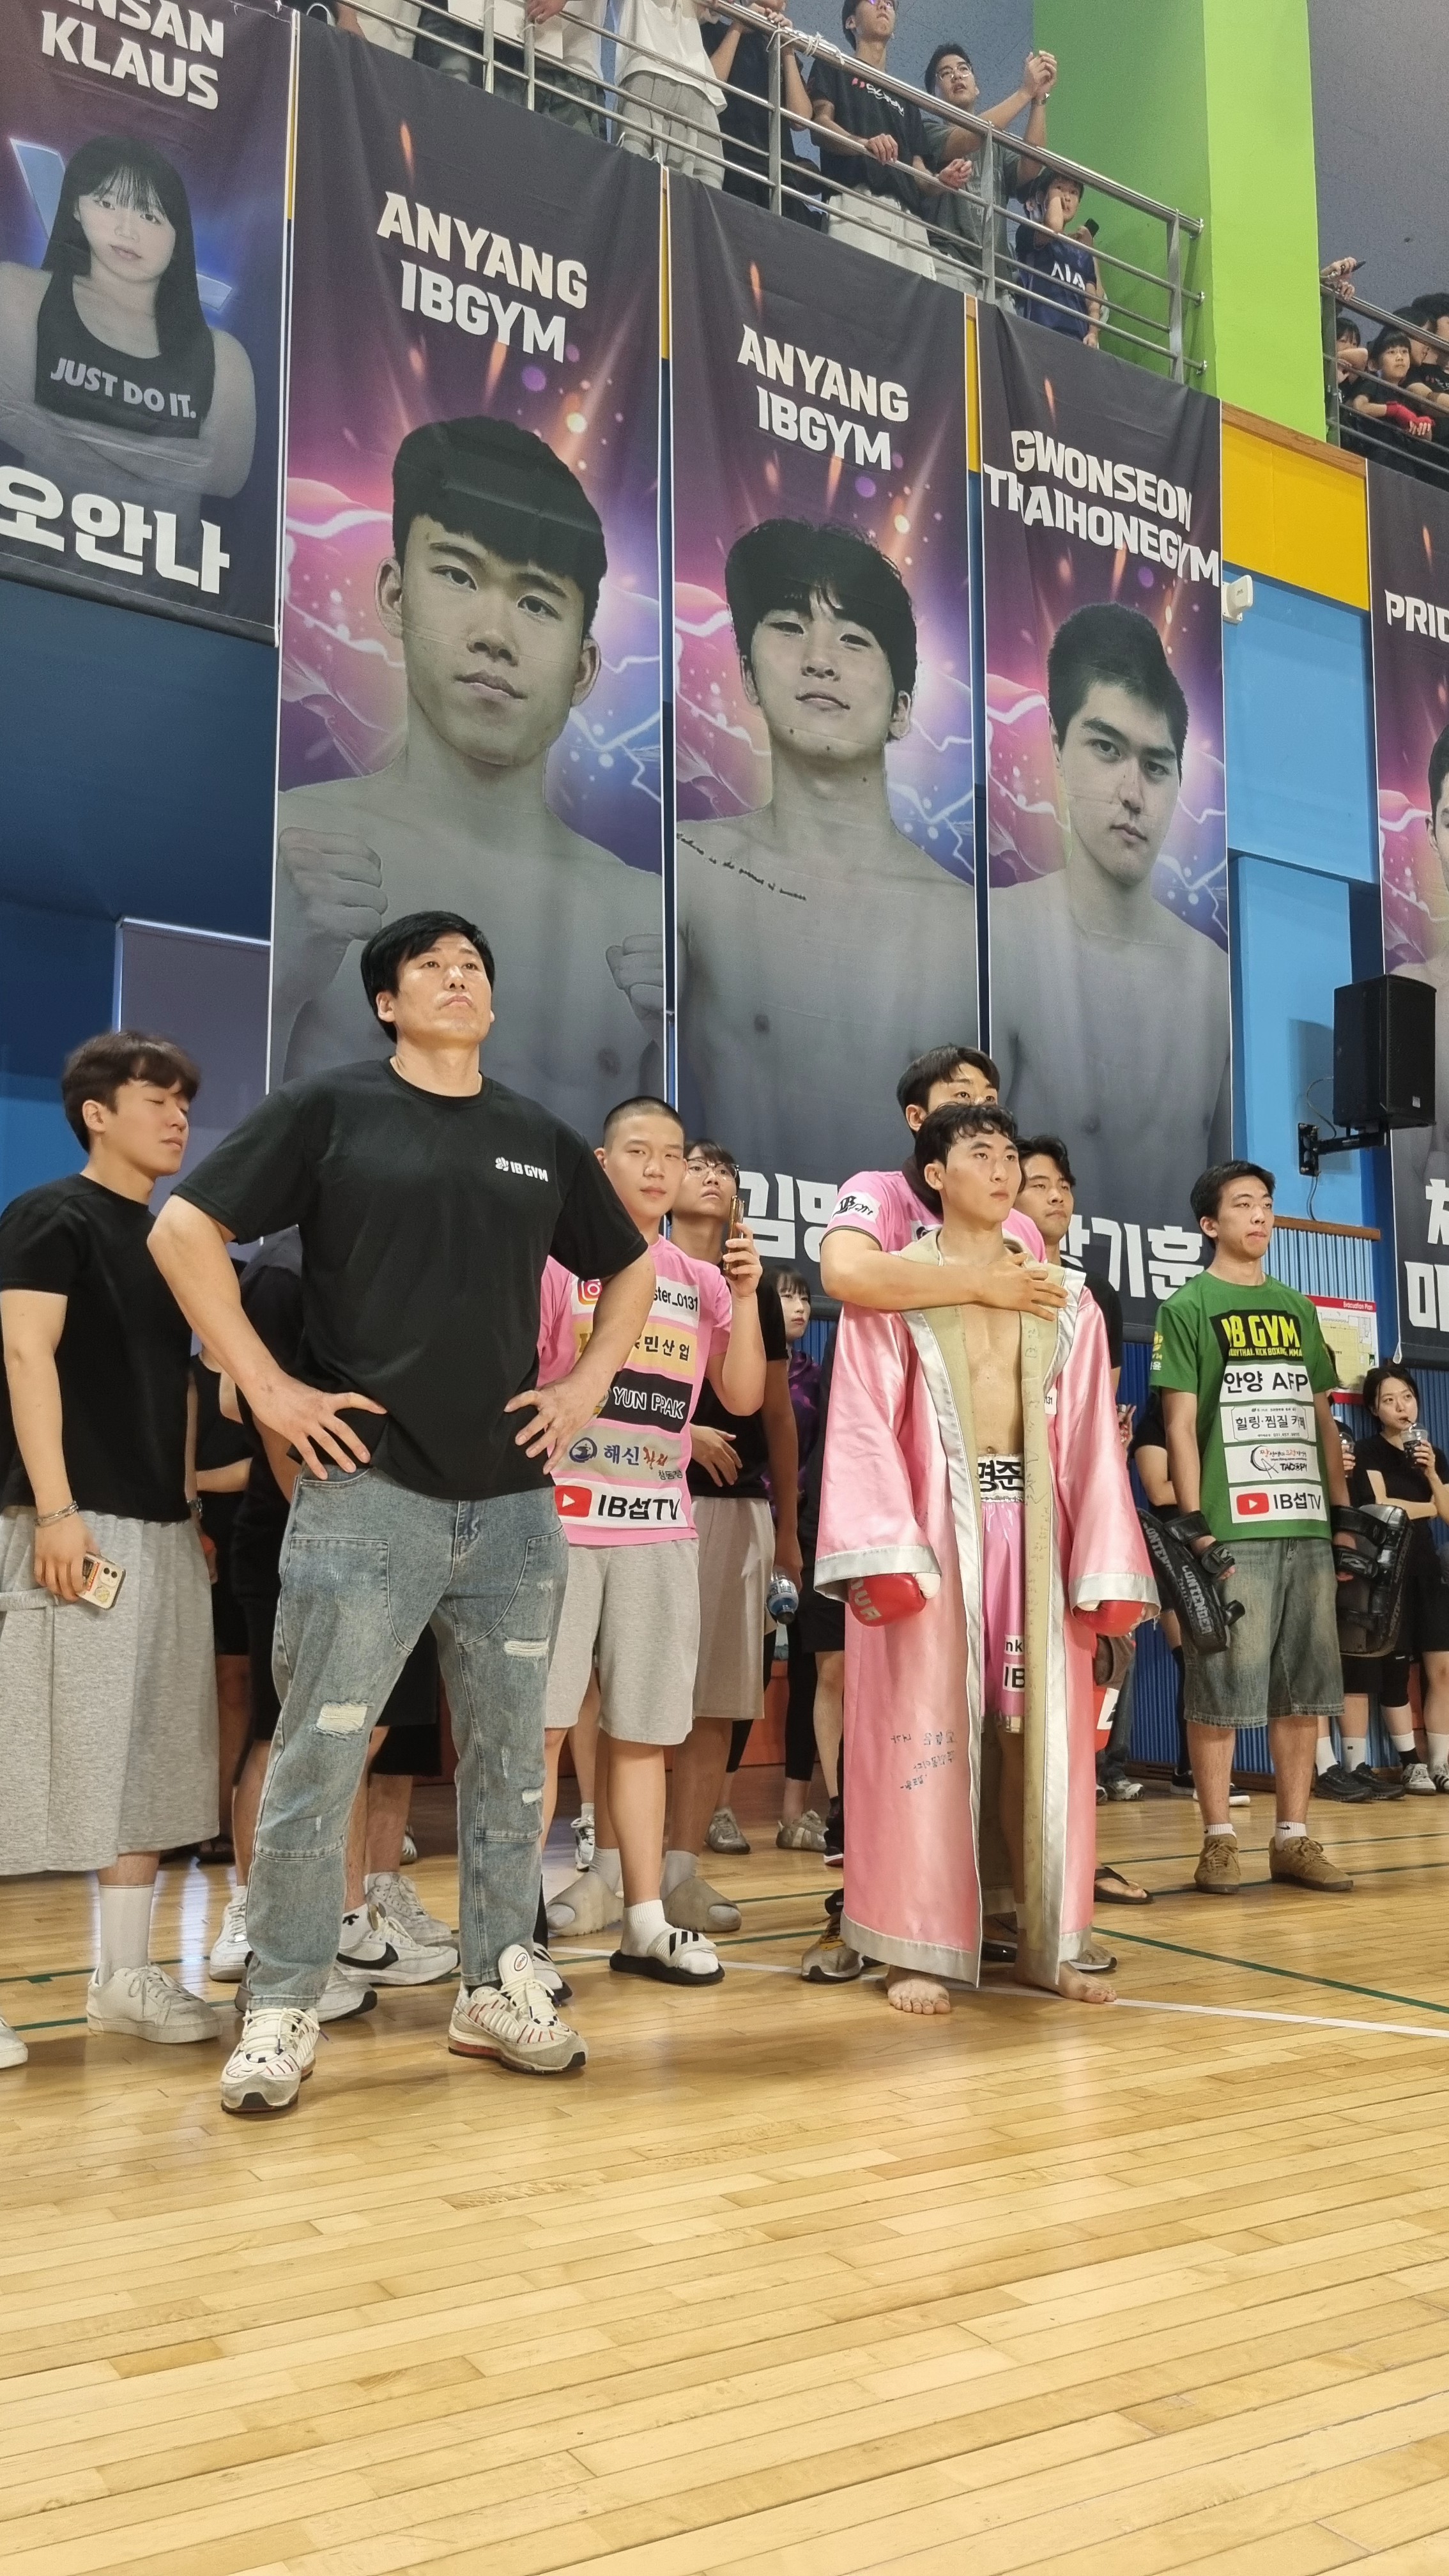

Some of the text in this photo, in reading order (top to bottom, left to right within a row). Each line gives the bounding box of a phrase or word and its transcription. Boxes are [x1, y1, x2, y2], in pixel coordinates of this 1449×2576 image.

[42, 10, 218, 110] KLAUS
[376, 191, 587, 309] ANYANG
[400, 259, 566, 363] IBGYM
[50, 357, 197, 418] JUST DO IT.
[737, 323, 908, 422] ANYANG
[756, 385, 891, 471] IBGYM
[1011, 430, 1192, 532] GWONSEON
[0, 465, 230, 595] 오안나
[510, 1161, 549, 1182] IB GYM
[1221, 1315, 1301, 1348] IB GYM
[1343, 1300, 1373, 1311] Evacuation Plan
[613, 1386, 647, 1410] YUN
[1223, 1370, 1263, 1394] 안양
[597, 1494, 680, 1521] IB섭TV
[1273, 1492, 1321, 1510] IB섭TV
